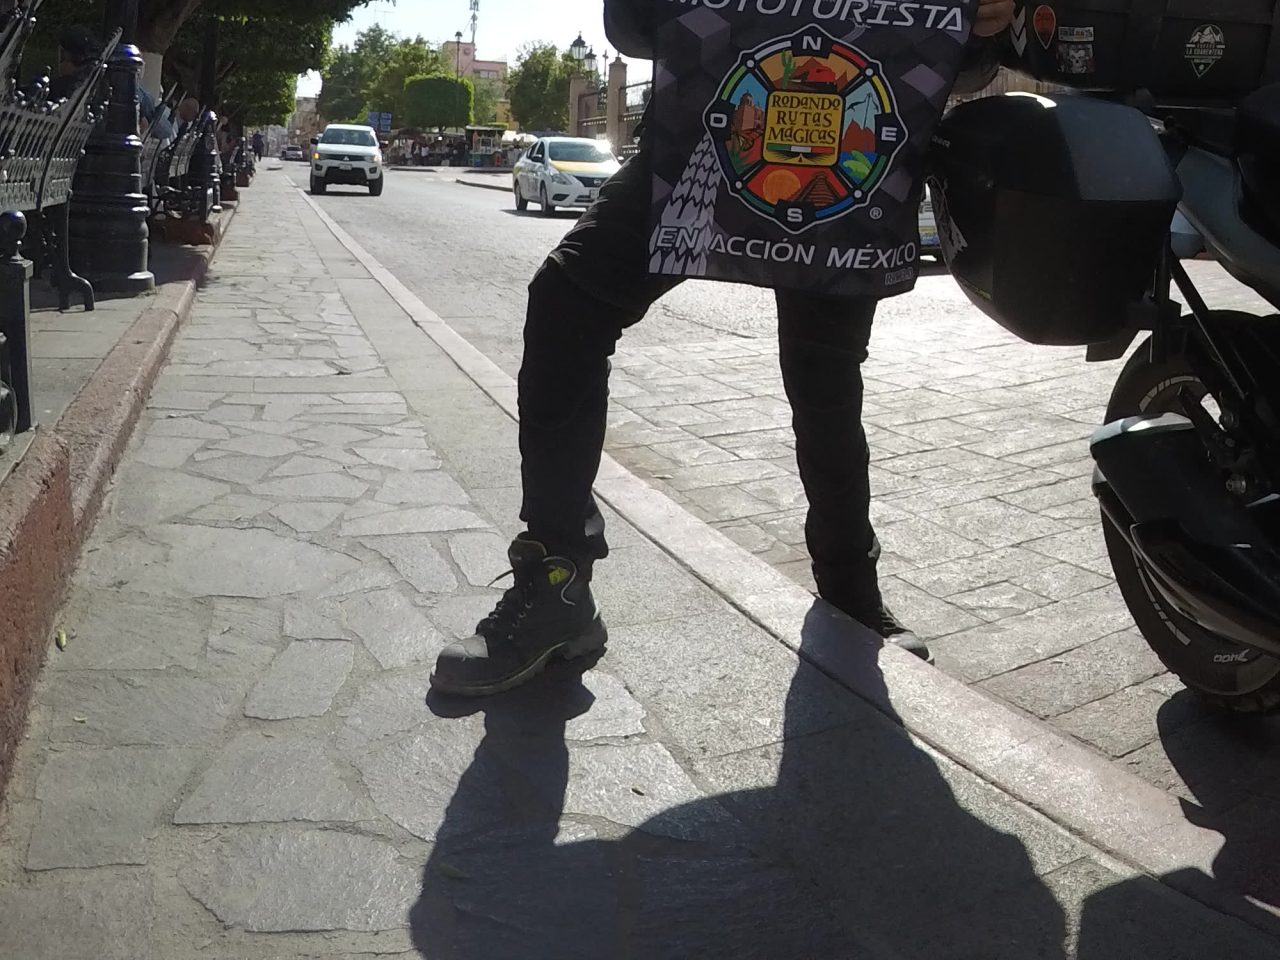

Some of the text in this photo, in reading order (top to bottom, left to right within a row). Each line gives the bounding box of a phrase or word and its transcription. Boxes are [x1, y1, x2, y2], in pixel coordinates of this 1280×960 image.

[802, 35, 822, 50] N
[709, 113, 728, 128] O
[881, 126, 898, 141] E
[786, 207, 803, 223] S
[656, 226, 917, 270] EN ACCIÓN MÉXICO
